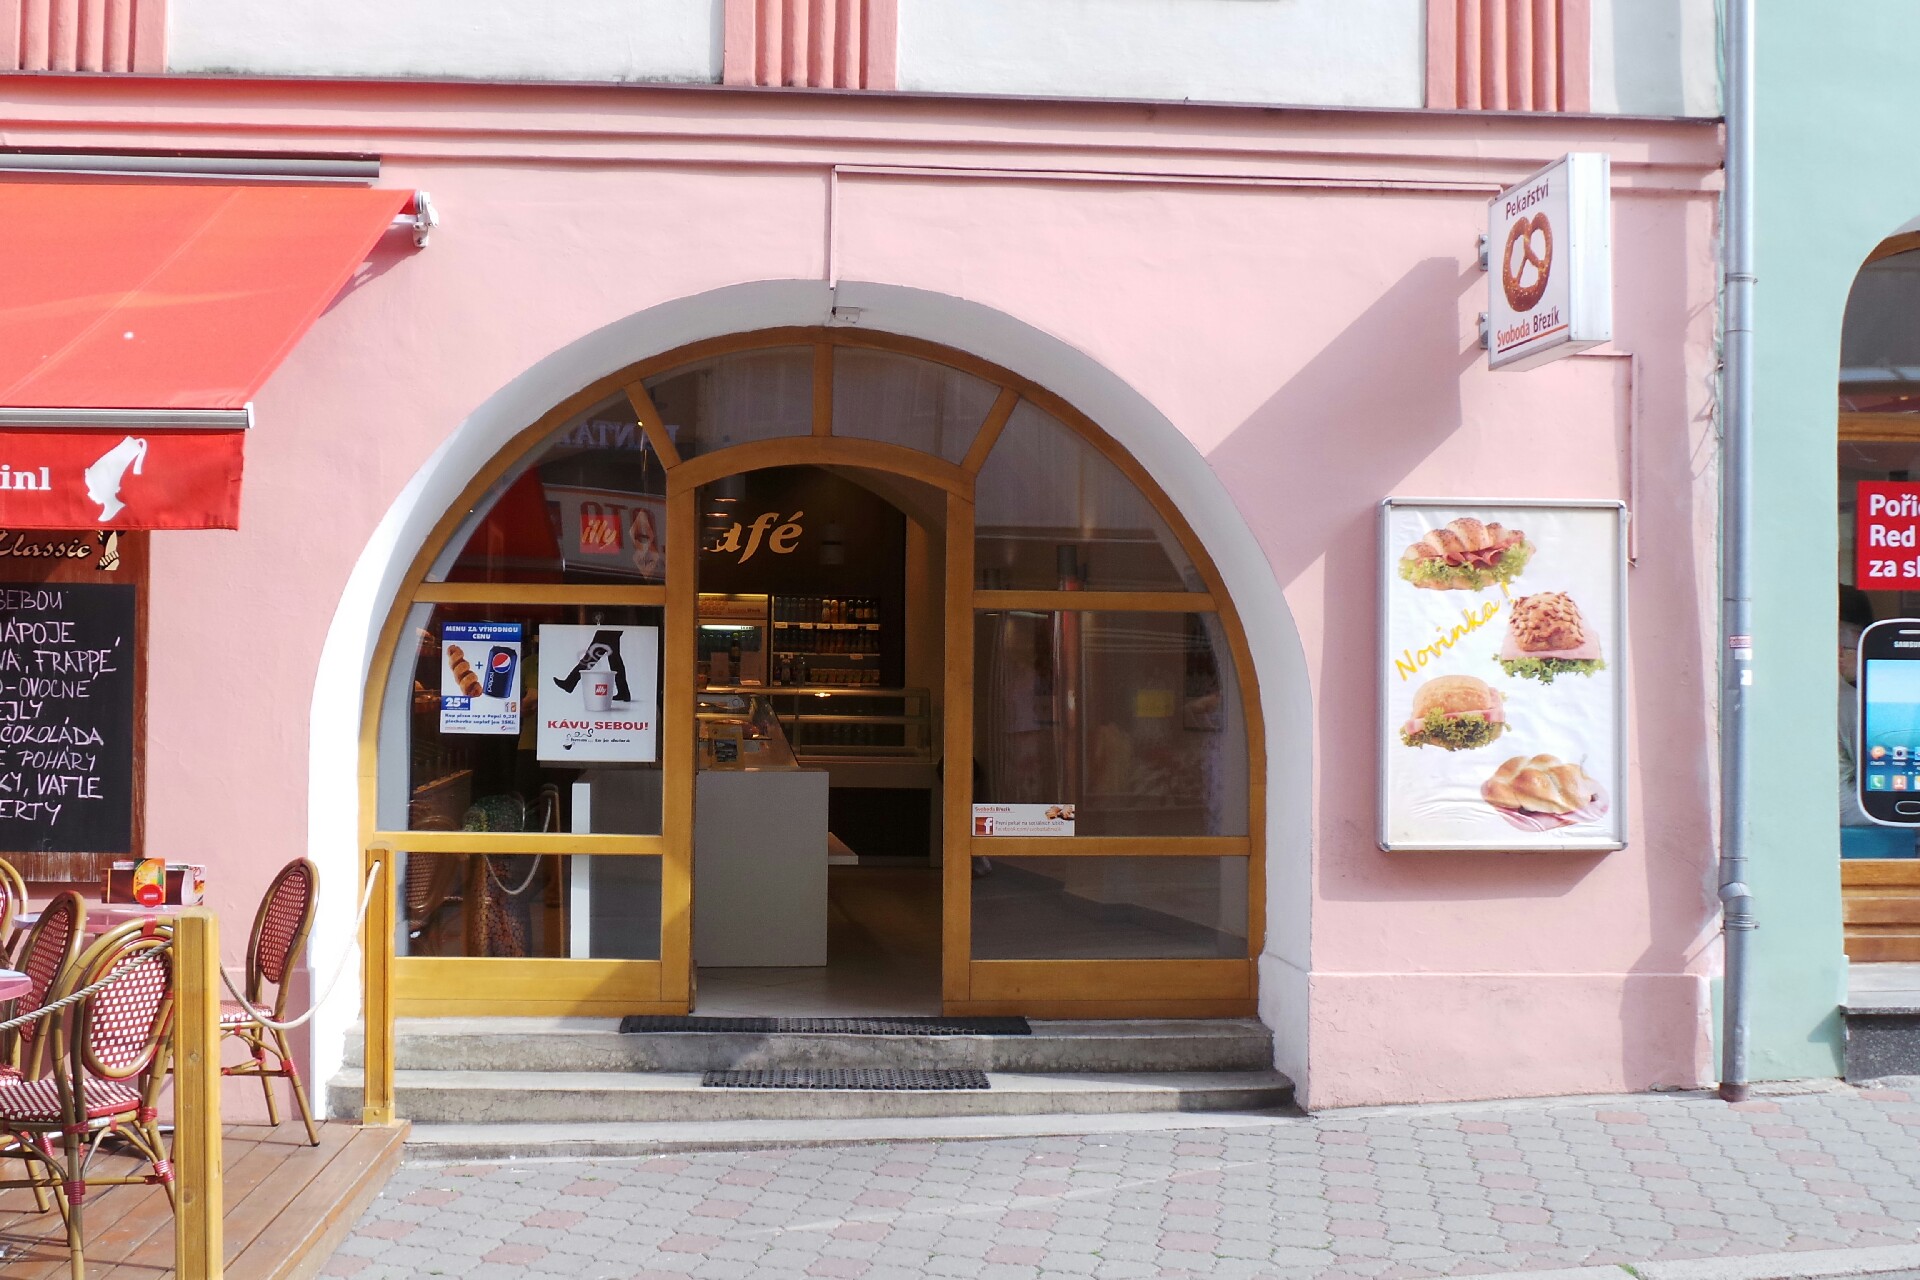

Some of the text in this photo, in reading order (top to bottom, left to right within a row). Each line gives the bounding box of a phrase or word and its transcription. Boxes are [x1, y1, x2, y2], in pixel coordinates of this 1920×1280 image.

[1505, 178, 1549, 220] Pekařství
[1497, 305, 1560, 347] Svoboda Březík
[1869, 493, 1920, 517] Poři
[581, 518, 618, 550] illy
[1869, 524, 1916, 547] Red
[1869, 560, 1897, 577] za
[0, 616, 76, 645] ÁPOJE
[478, 625, 519, 633] VÝHODNOU
[1394, 598, 1500, 682] Novinka
[33, 636, 121, 675] FRAPPÉ
[0, 671, 99, 699] -OVOCNÉ
[0, 717, 105, 746] ČOKOLÁDA
[547, 718, 649, 731] KÁVU SEBOU!
[16, 745, 96, 772] POHÁRY
[37, 773, 104, 799] VAFLE
[0, 799, 62, 826] ERTY
